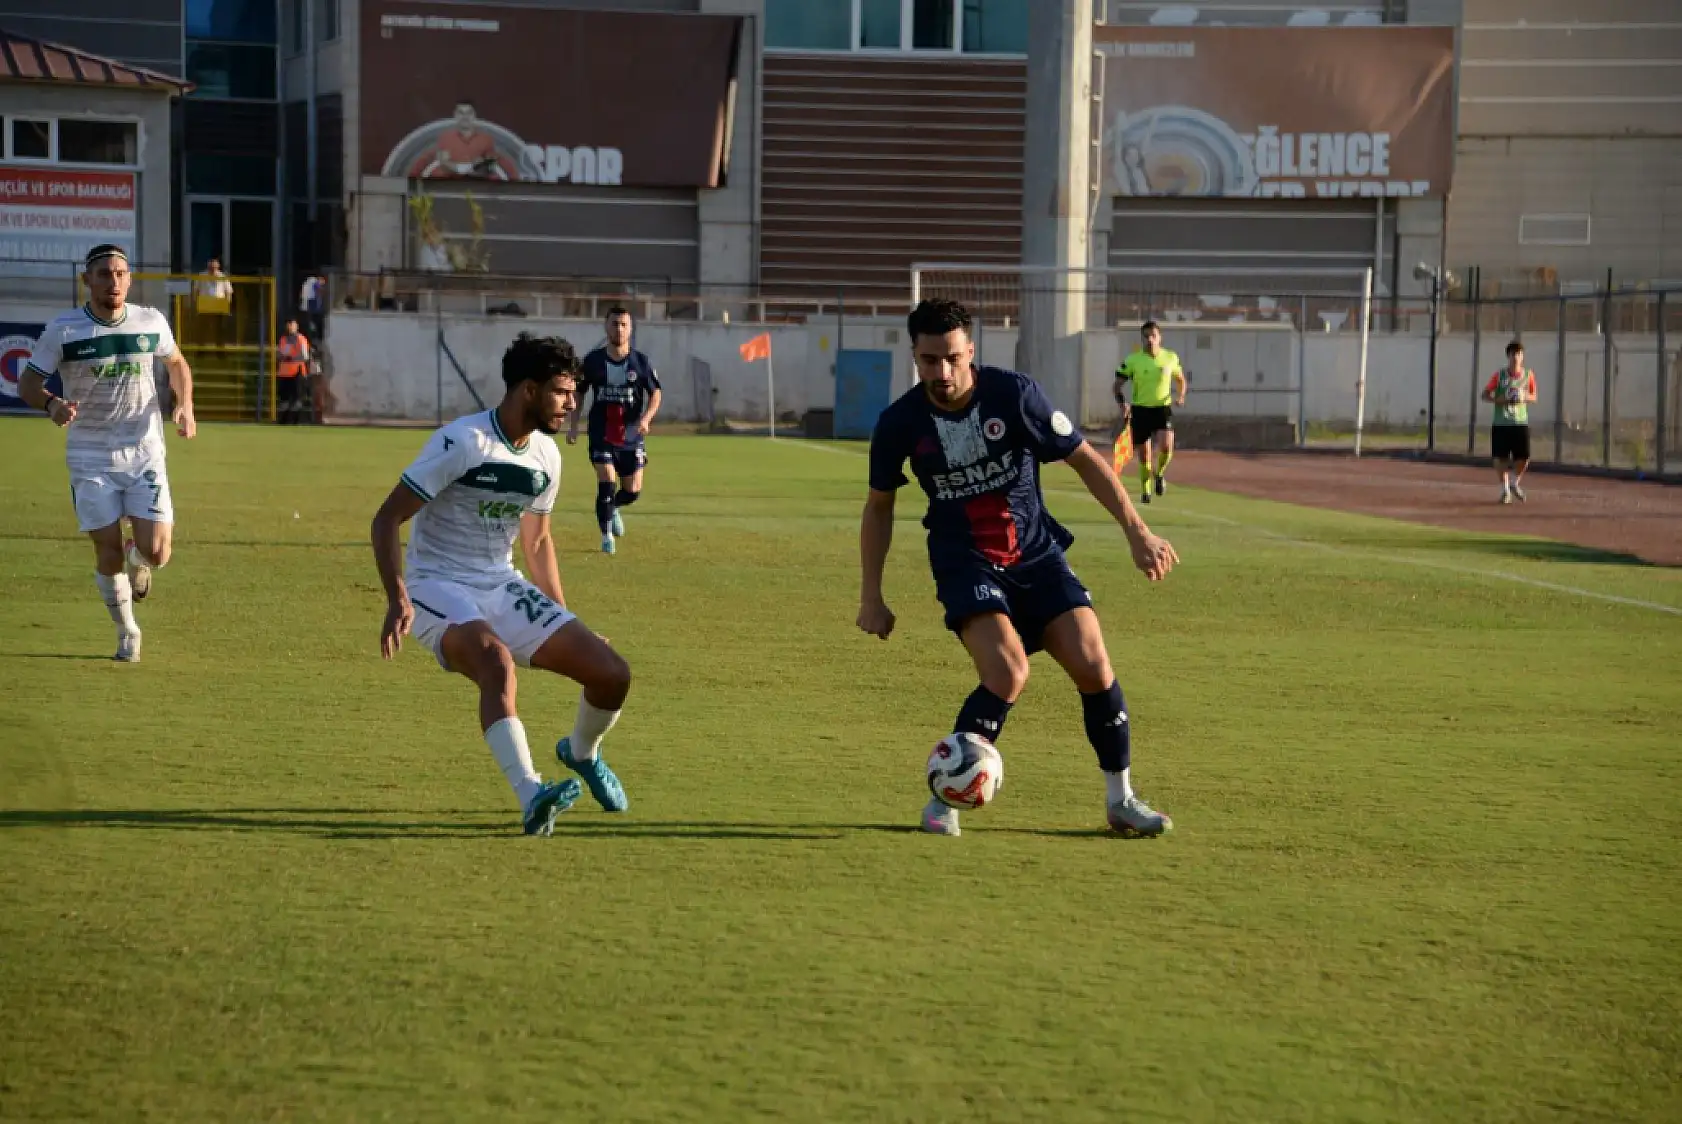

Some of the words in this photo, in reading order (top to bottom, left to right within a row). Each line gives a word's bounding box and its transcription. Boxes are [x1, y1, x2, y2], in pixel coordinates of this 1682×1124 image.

[32, 181, 45, 197] VE
[48, 181, 75, 197] SPOR
[932, 450, 1013, 487] ESNAF
[148, 484, 161, 505] 7
